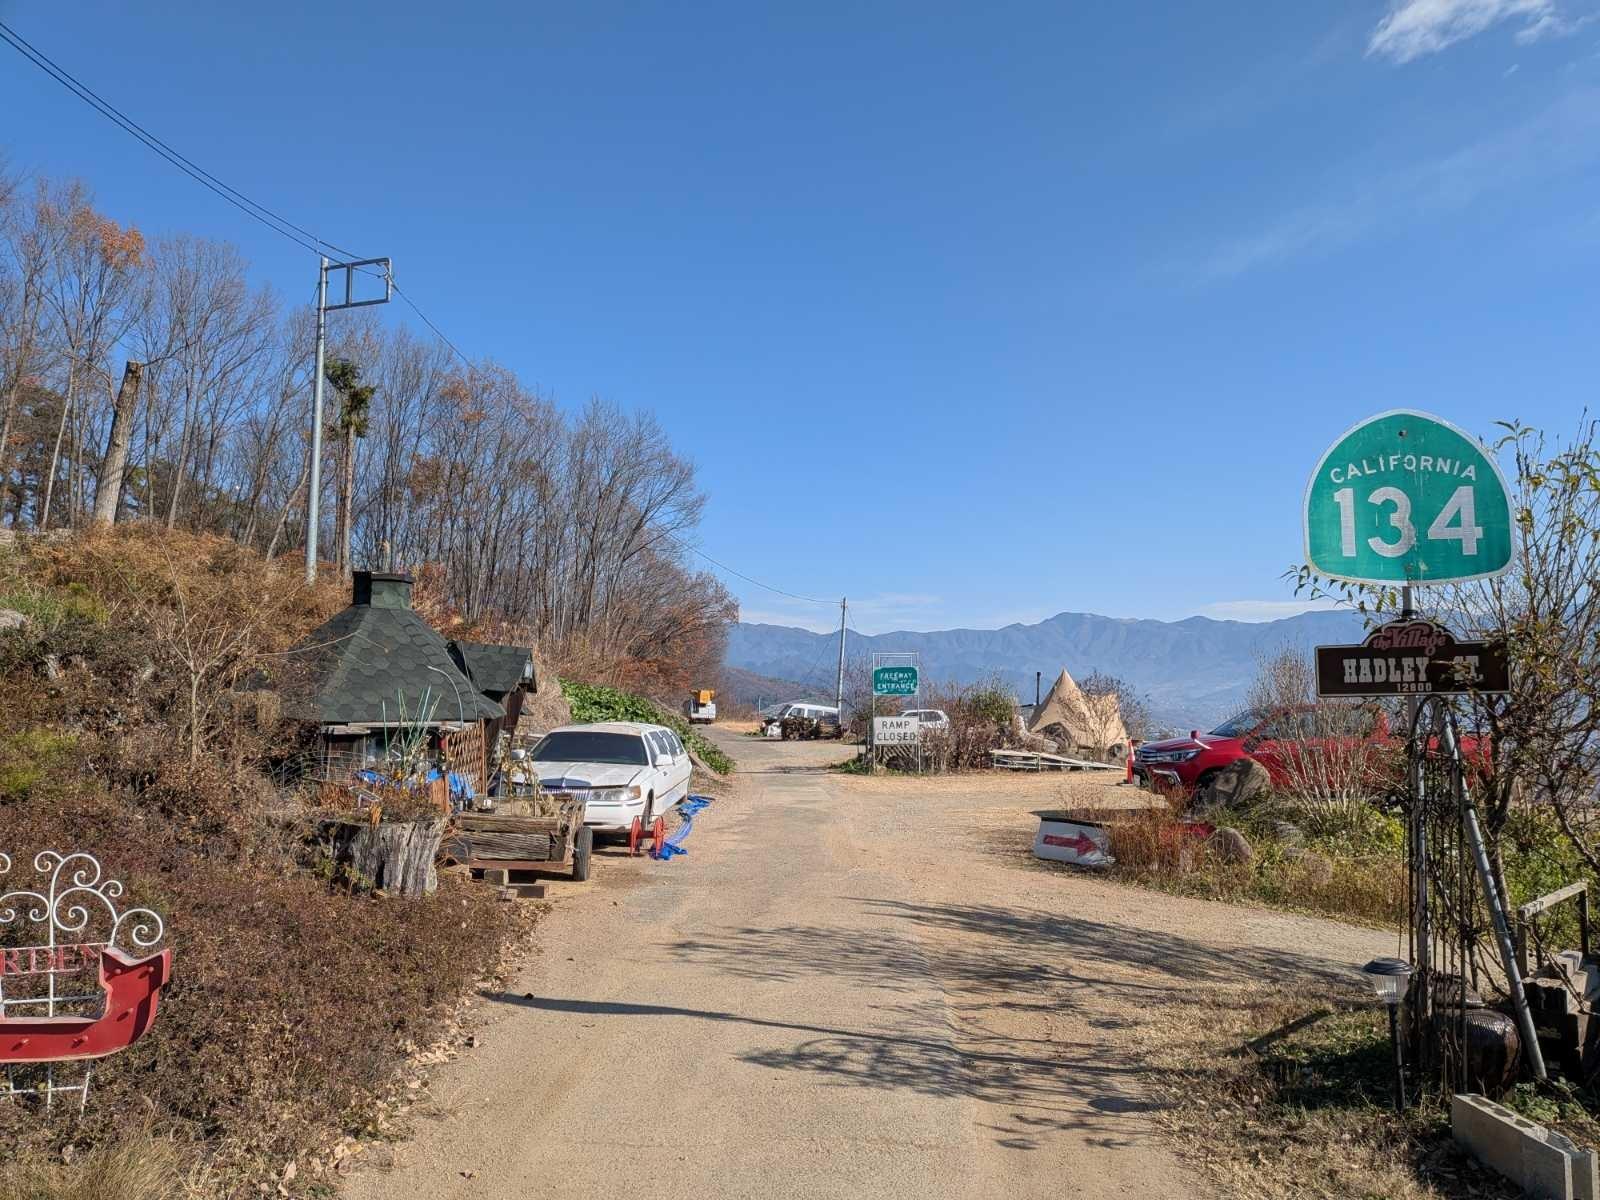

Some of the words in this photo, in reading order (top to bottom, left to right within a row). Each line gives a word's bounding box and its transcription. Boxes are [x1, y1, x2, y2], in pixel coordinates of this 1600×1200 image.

[1330, 454, 1477, 484] CALIFORNIA
[1334, 485, 1484, 558] 134
[1383, 624, 1447, 656] Village
[1342, 656, 1430, 683] HADLEY
[877, 682, 915, 690] ENTRANCE
[877, 732, 916, 741] CLOSED
[881, 720, 911, 730] RAMP
